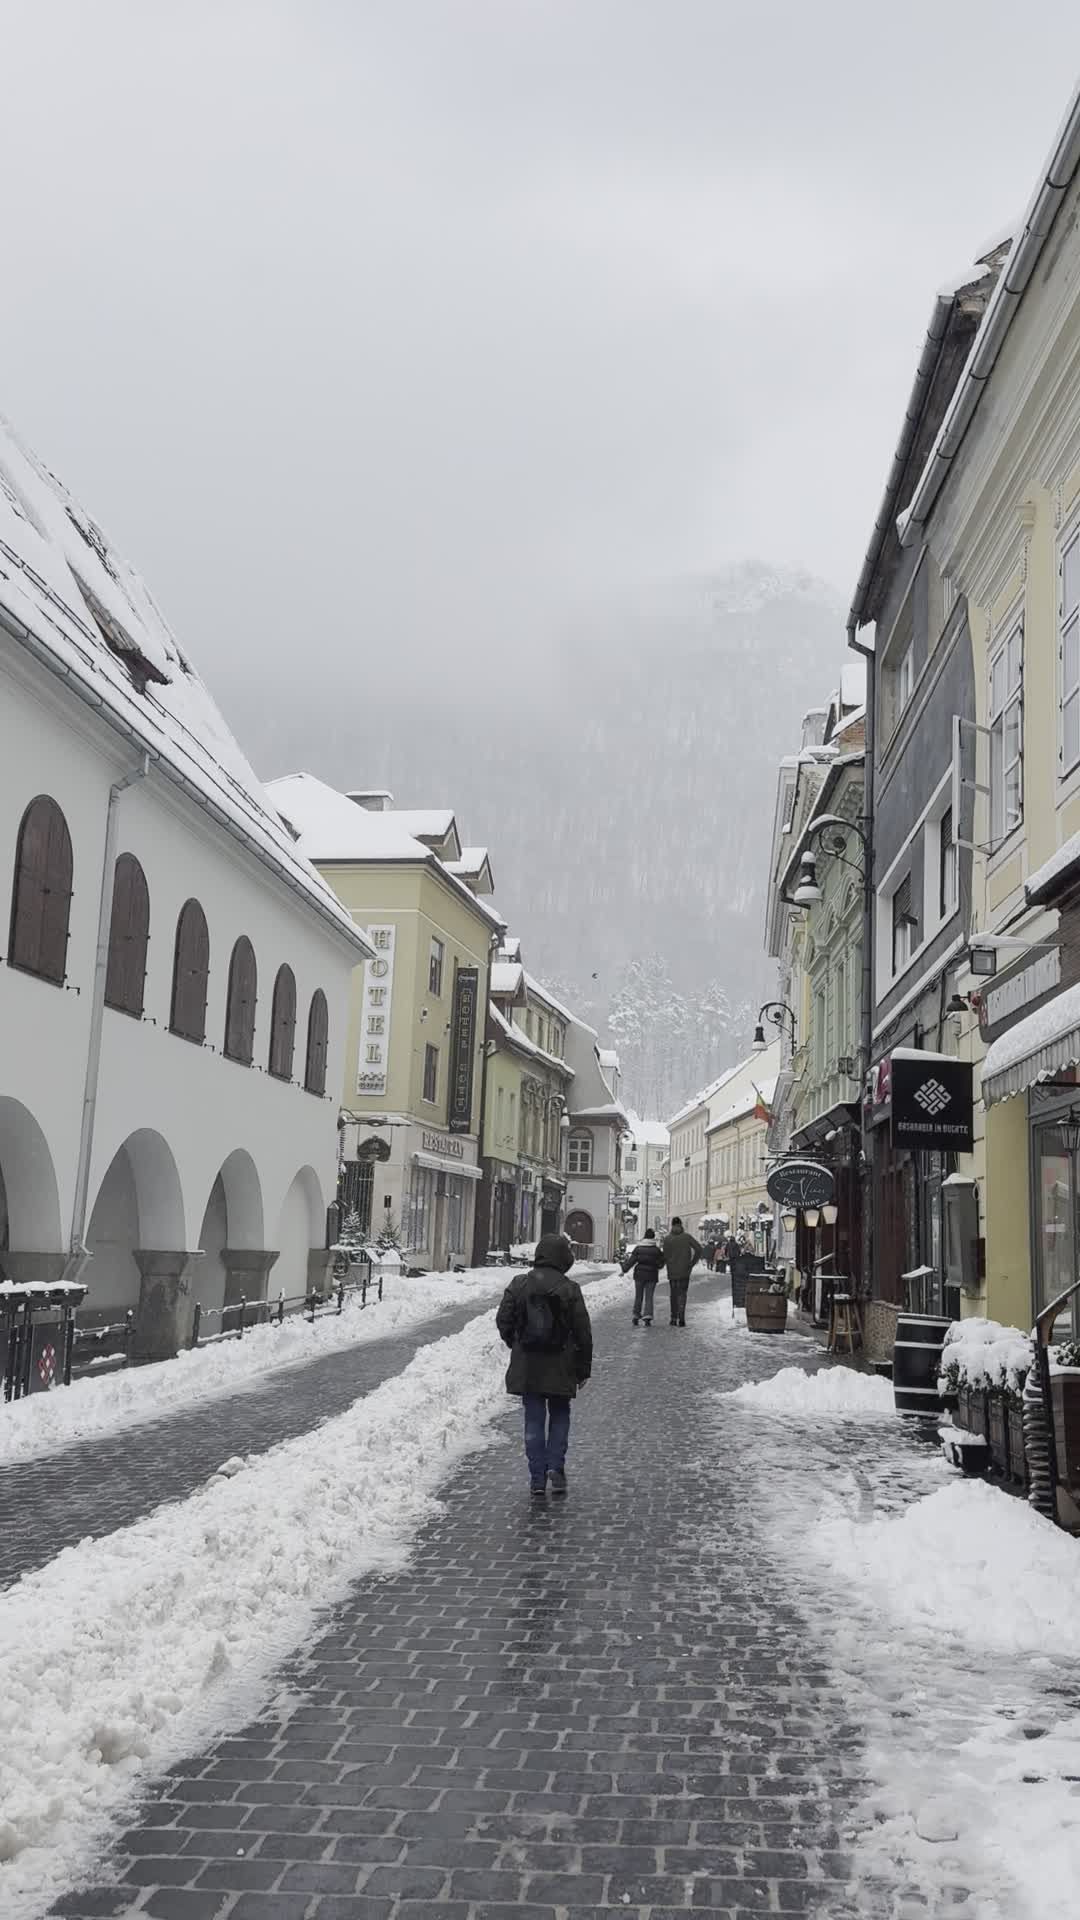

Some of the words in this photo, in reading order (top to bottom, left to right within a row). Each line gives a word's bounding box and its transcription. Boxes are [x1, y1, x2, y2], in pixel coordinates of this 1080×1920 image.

[365, 929, 391, 1064] HOTEL
[461, 994, 471, 1048] HOTEL
[779, 1168, 822, 1178] Restaurant
[782, 1197, 821, 1206] Pensiune
